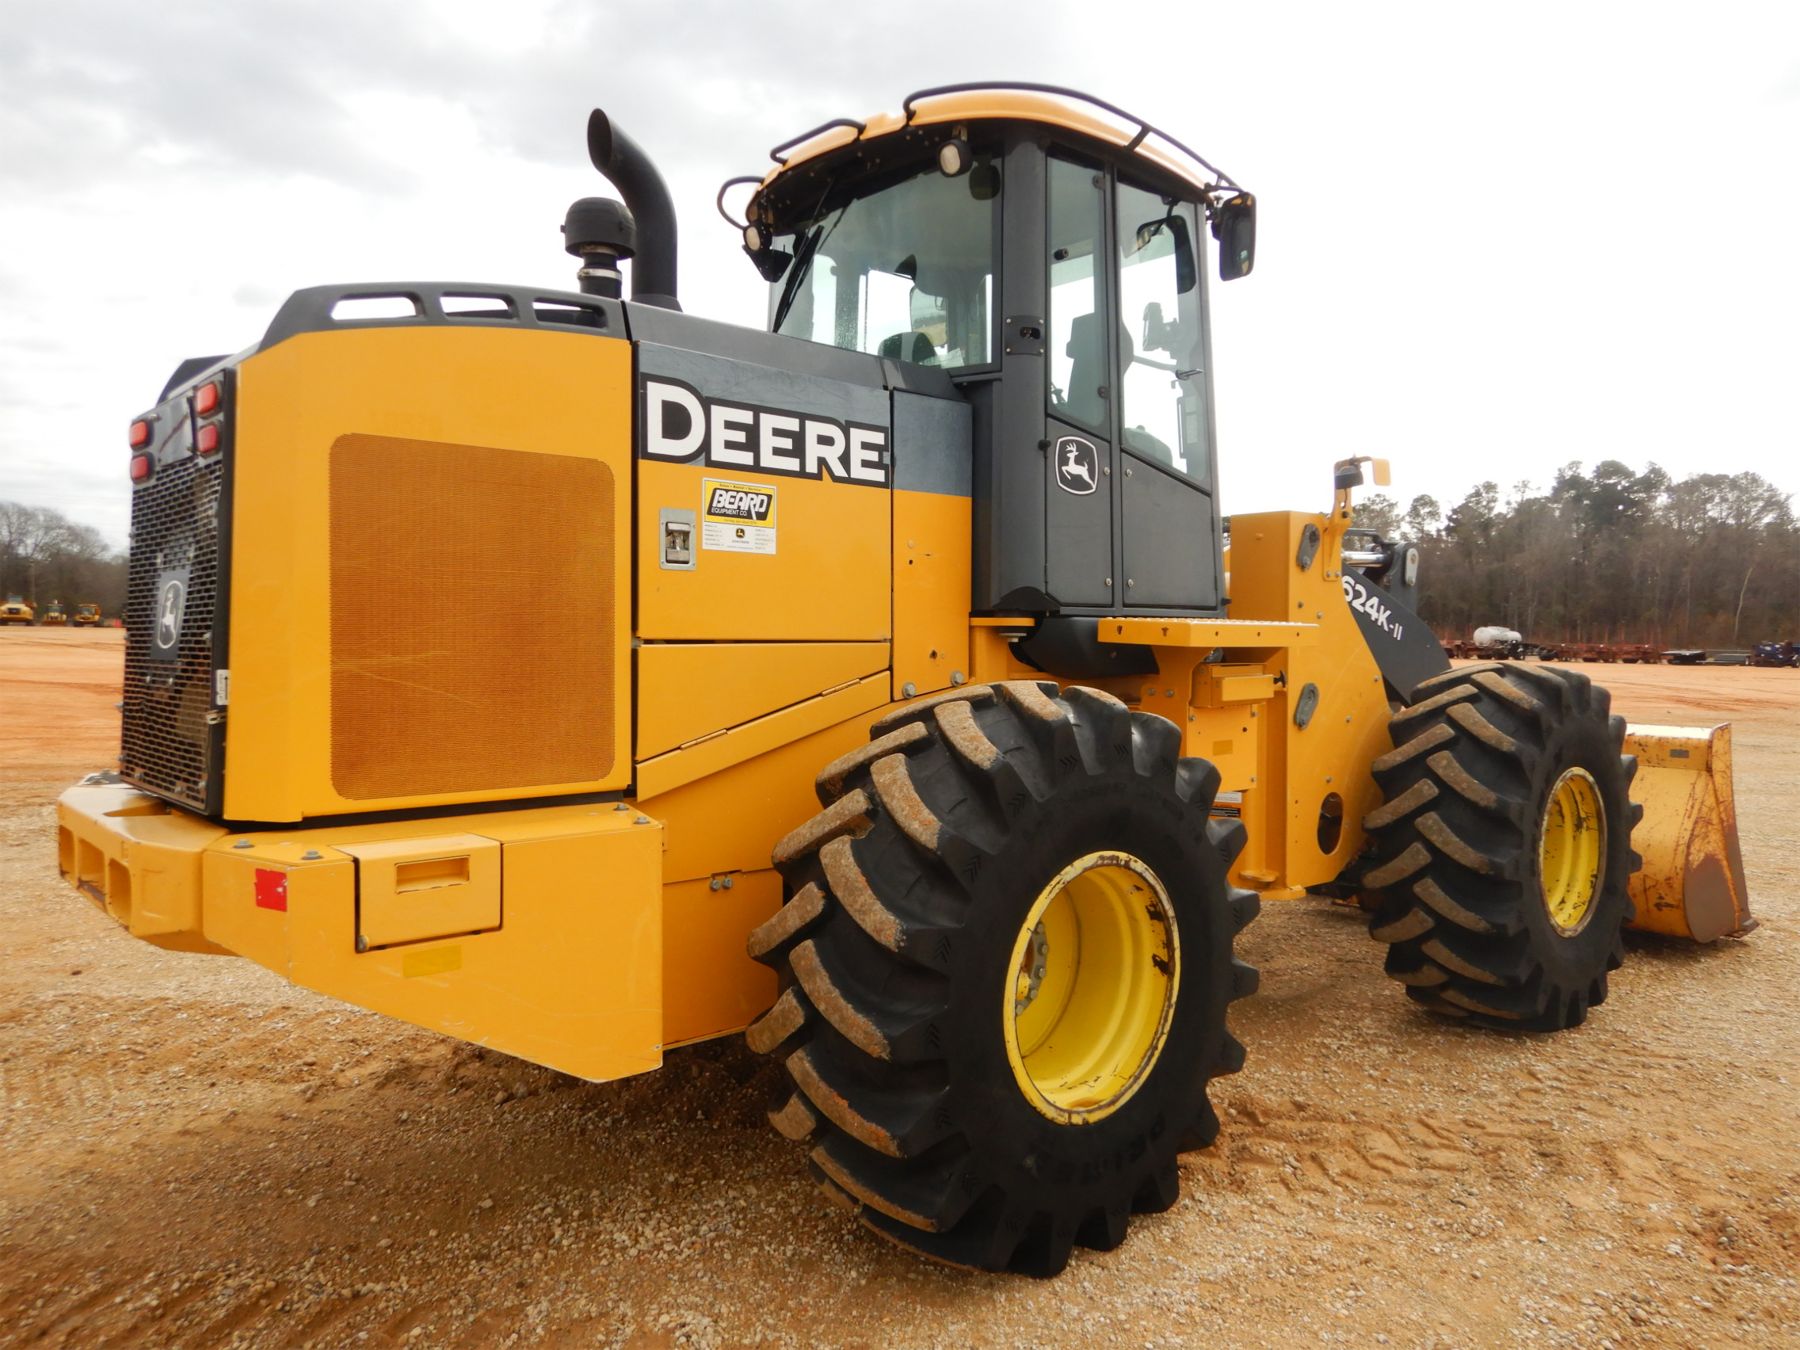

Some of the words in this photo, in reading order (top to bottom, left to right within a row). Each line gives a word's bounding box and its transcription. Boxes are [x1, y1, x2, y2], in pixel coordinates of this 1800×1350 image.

[646, 380, 886, 483] DEERE
[711, 506, 740, 516] EQUIPMENT
[712, 489, 768, 520] BEARD
